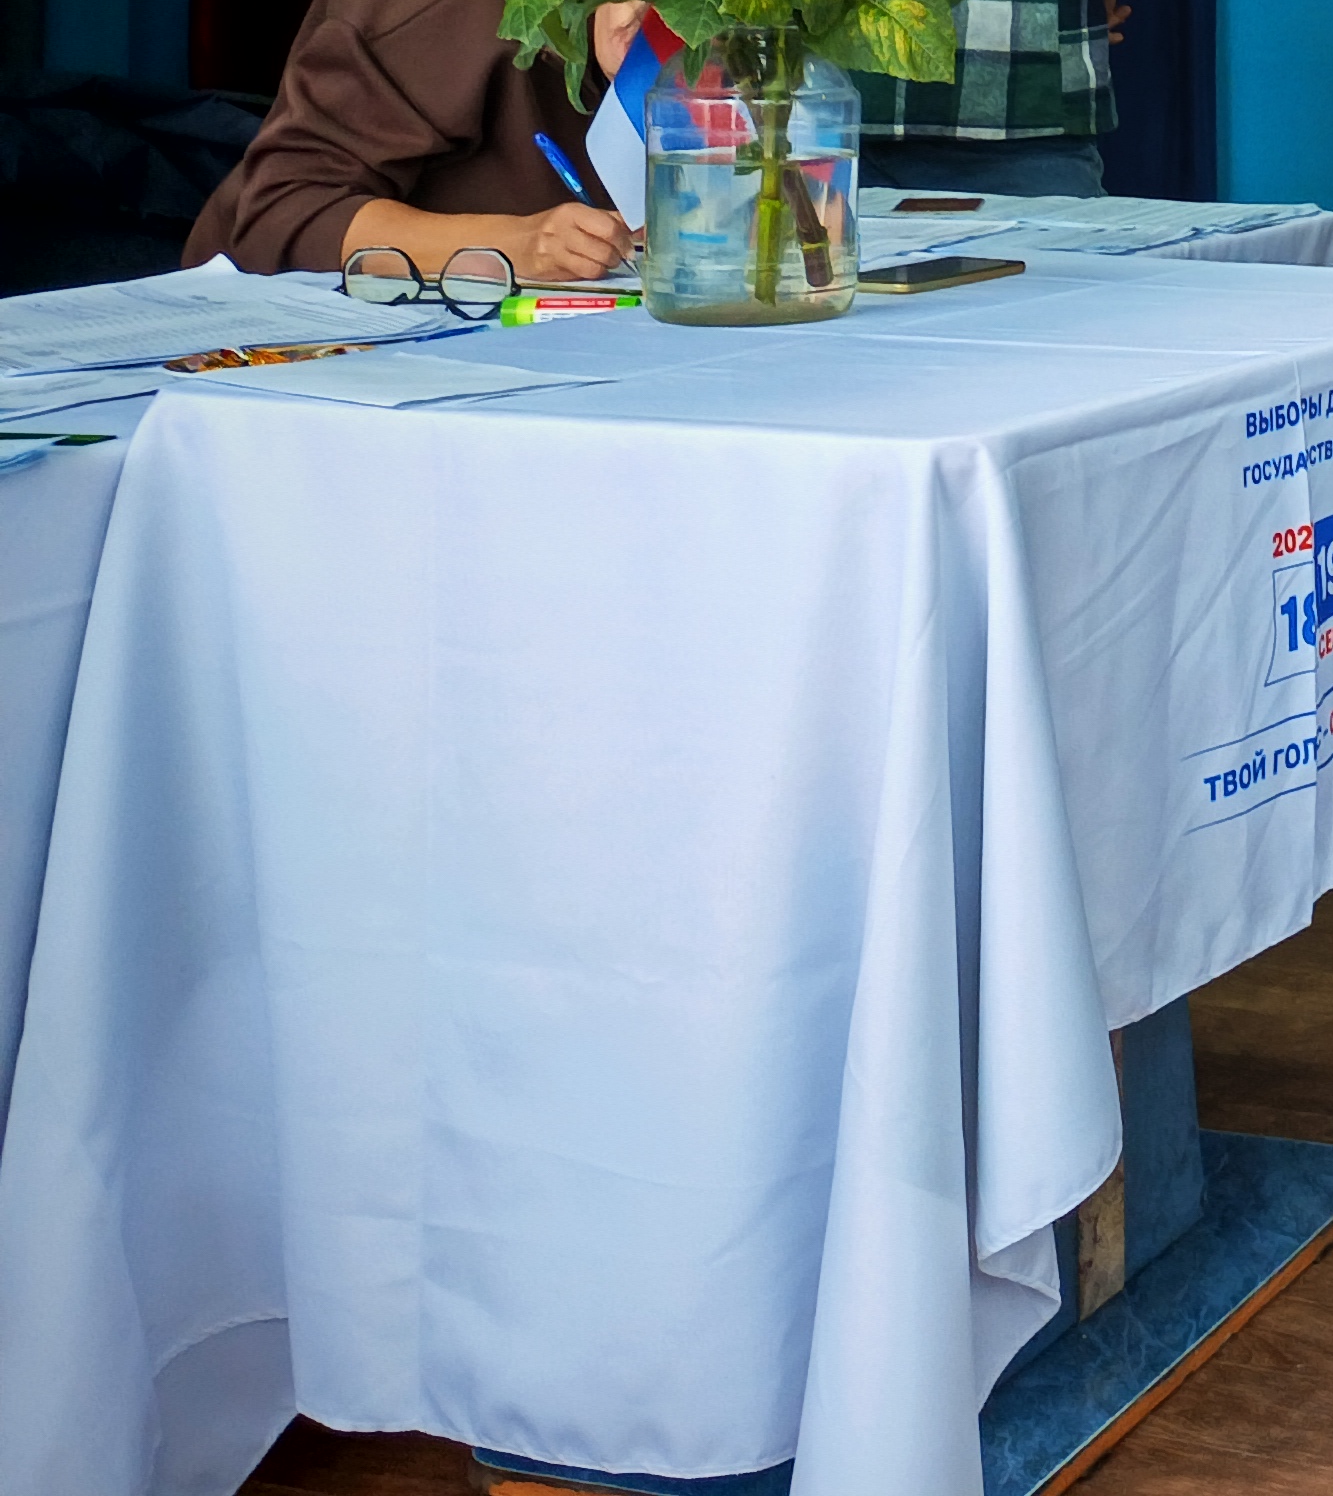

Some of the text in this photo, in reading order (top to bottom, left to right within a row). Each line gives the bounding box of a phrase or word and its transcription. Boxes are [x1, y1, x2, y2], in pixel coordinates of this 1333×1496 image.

[1246, 393, 1322, 439] ВЫБОРЫ
[1272, 521, 1314, 558] 202
[1203, 748, 1266, 802] ТВОЙ
